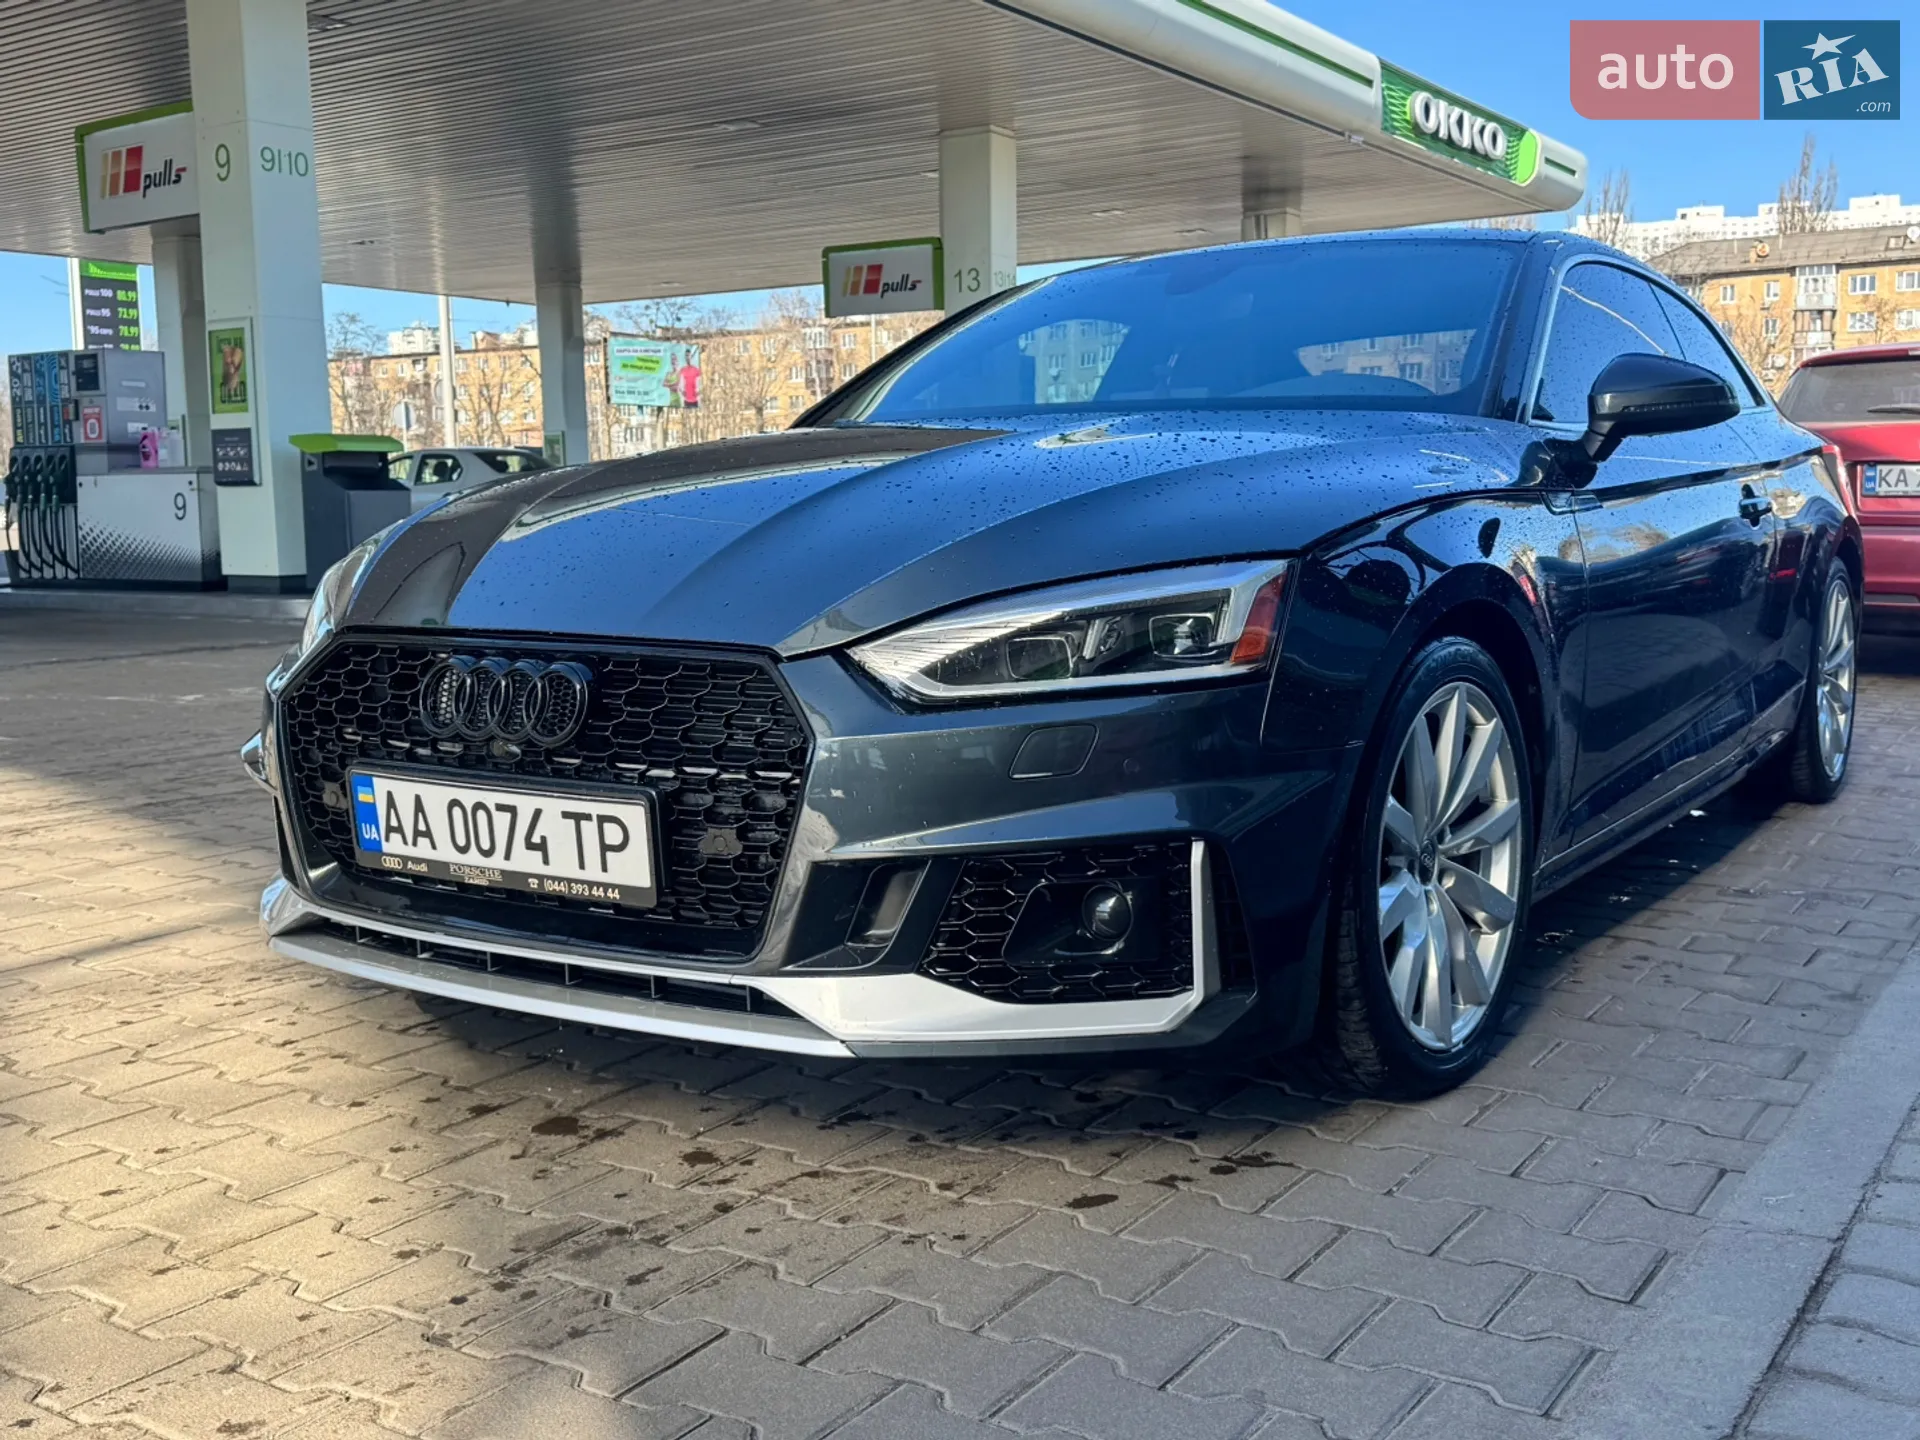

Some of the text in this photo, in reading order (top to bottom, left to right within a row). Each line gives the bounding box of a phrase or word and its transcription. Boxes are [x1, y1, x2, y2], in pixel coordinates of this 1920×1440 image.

[214, 142, 231, 182] 9
[142, 158, 187, 198] pulls
[880, 273, 922, 298] pulls
[954, 267, 981, 293] 13
[1878, 468, 1909, 488] KA
[173, 492, 187, 521] 9
[361, 822, 380, 841] UA
[384, 790, 631, 873] AA 0074 TP
[406, 860, 428, 872] Audi
[543, 877, 621, 900] (044) 393 44 44
